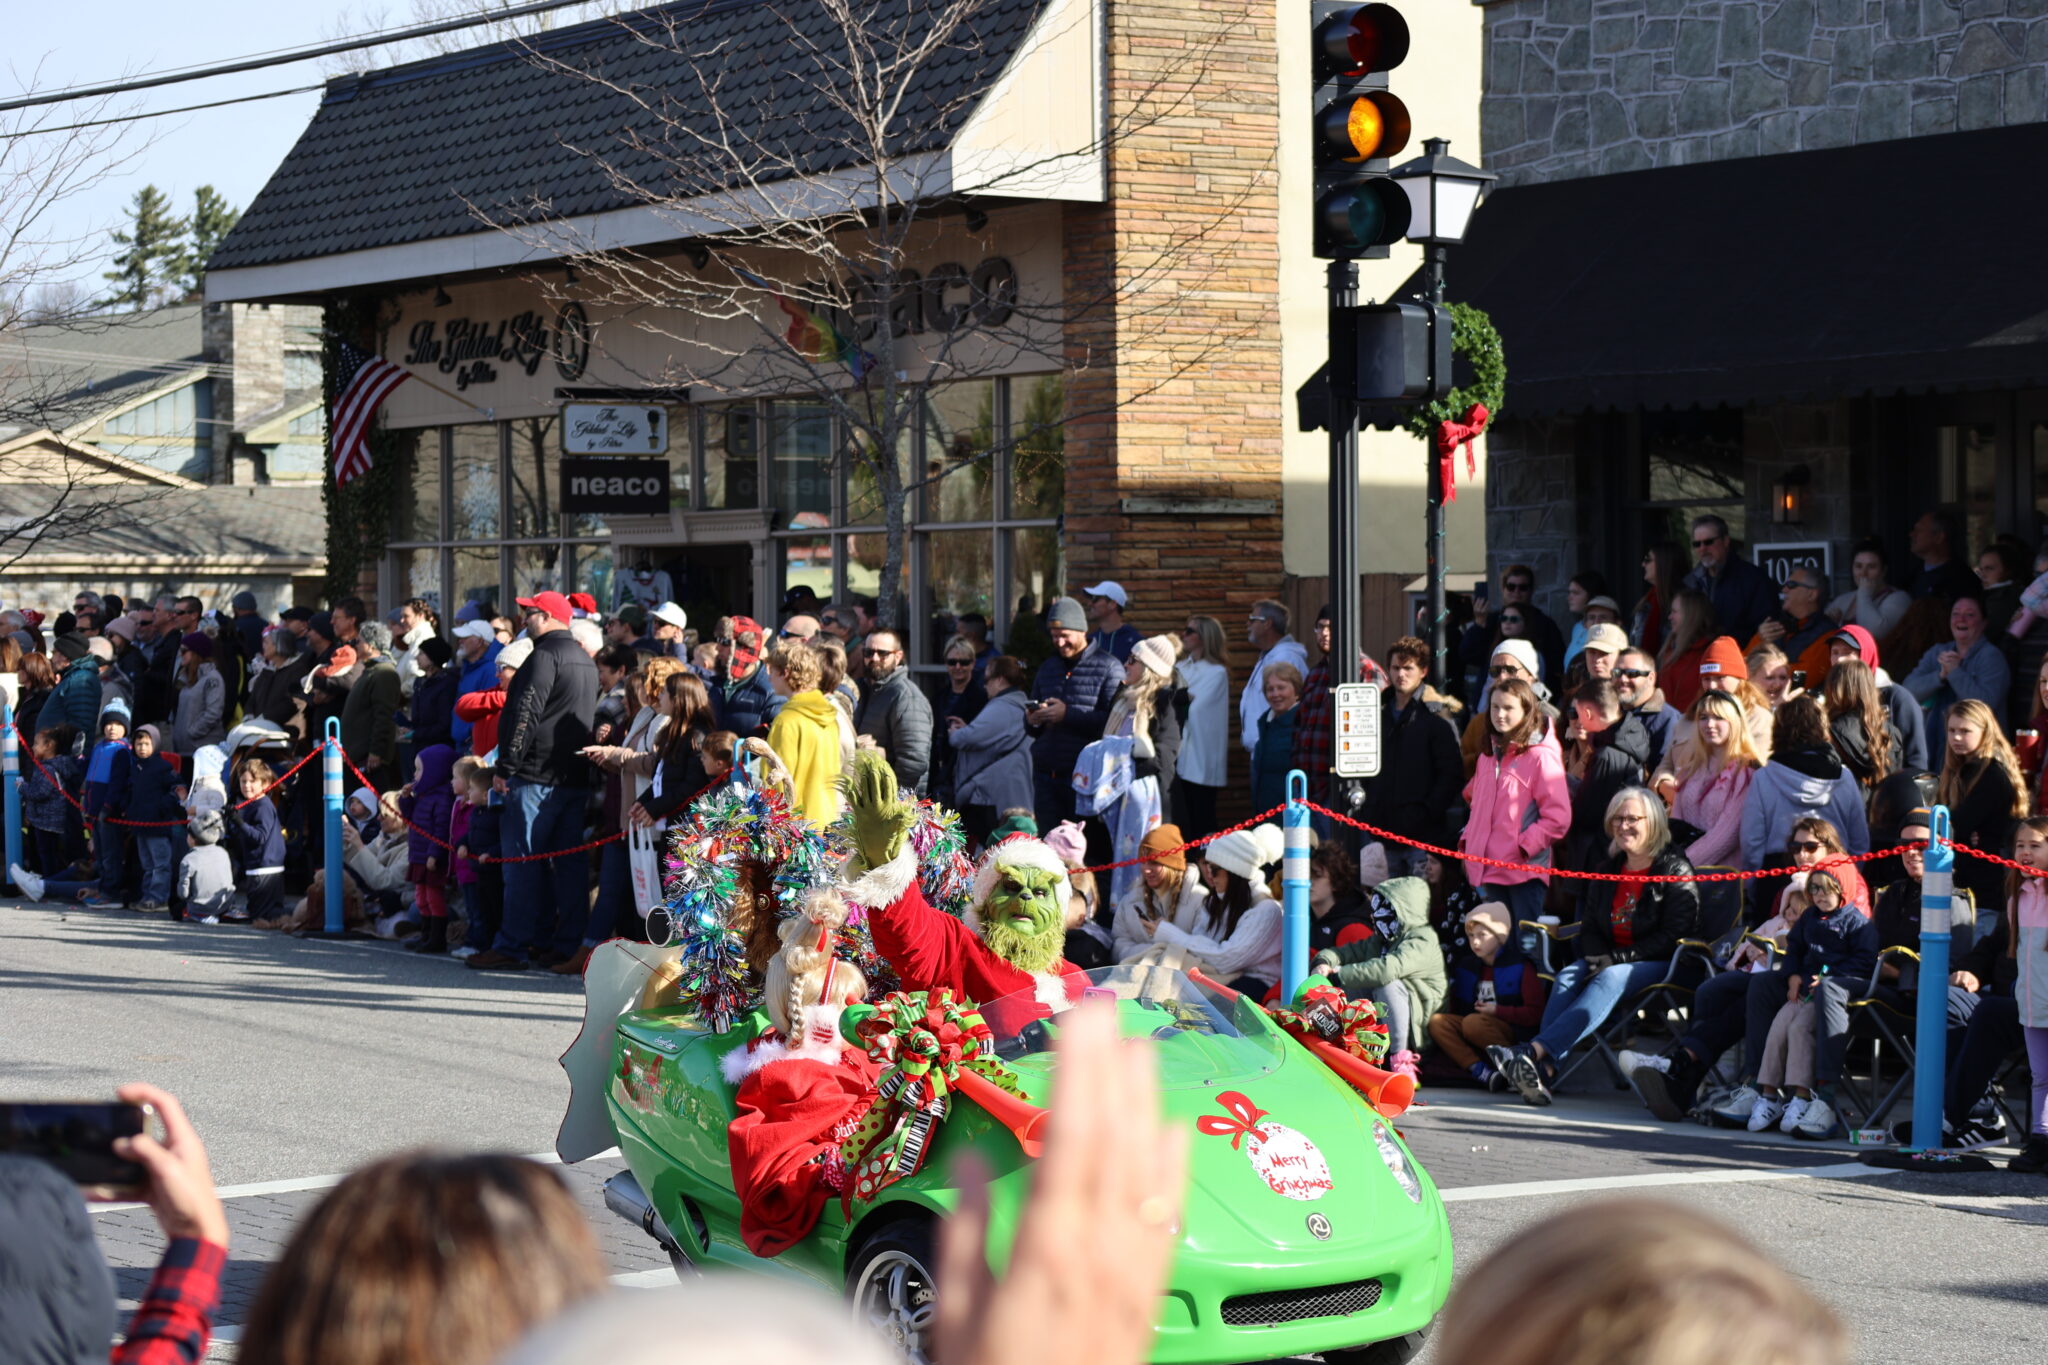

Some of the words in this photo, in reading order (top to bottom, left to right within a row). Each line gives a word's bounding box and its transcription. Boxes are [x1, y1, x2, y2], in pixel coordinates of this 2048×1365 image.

[405, 320, 442, 365] The
[439, 317, 508, 374] Gilded
[500, 310, 548, 376] Lily
[596, 408, 620, 422] The
[571, 421, 610, 438] Gilded
[611, 421, 638, 438] Lily
[571, 477, 661, 496] neaco
[1269, 1152, 1309, 1170] Merry
[1268, 1175, 1334, 1194] Grinchmas
